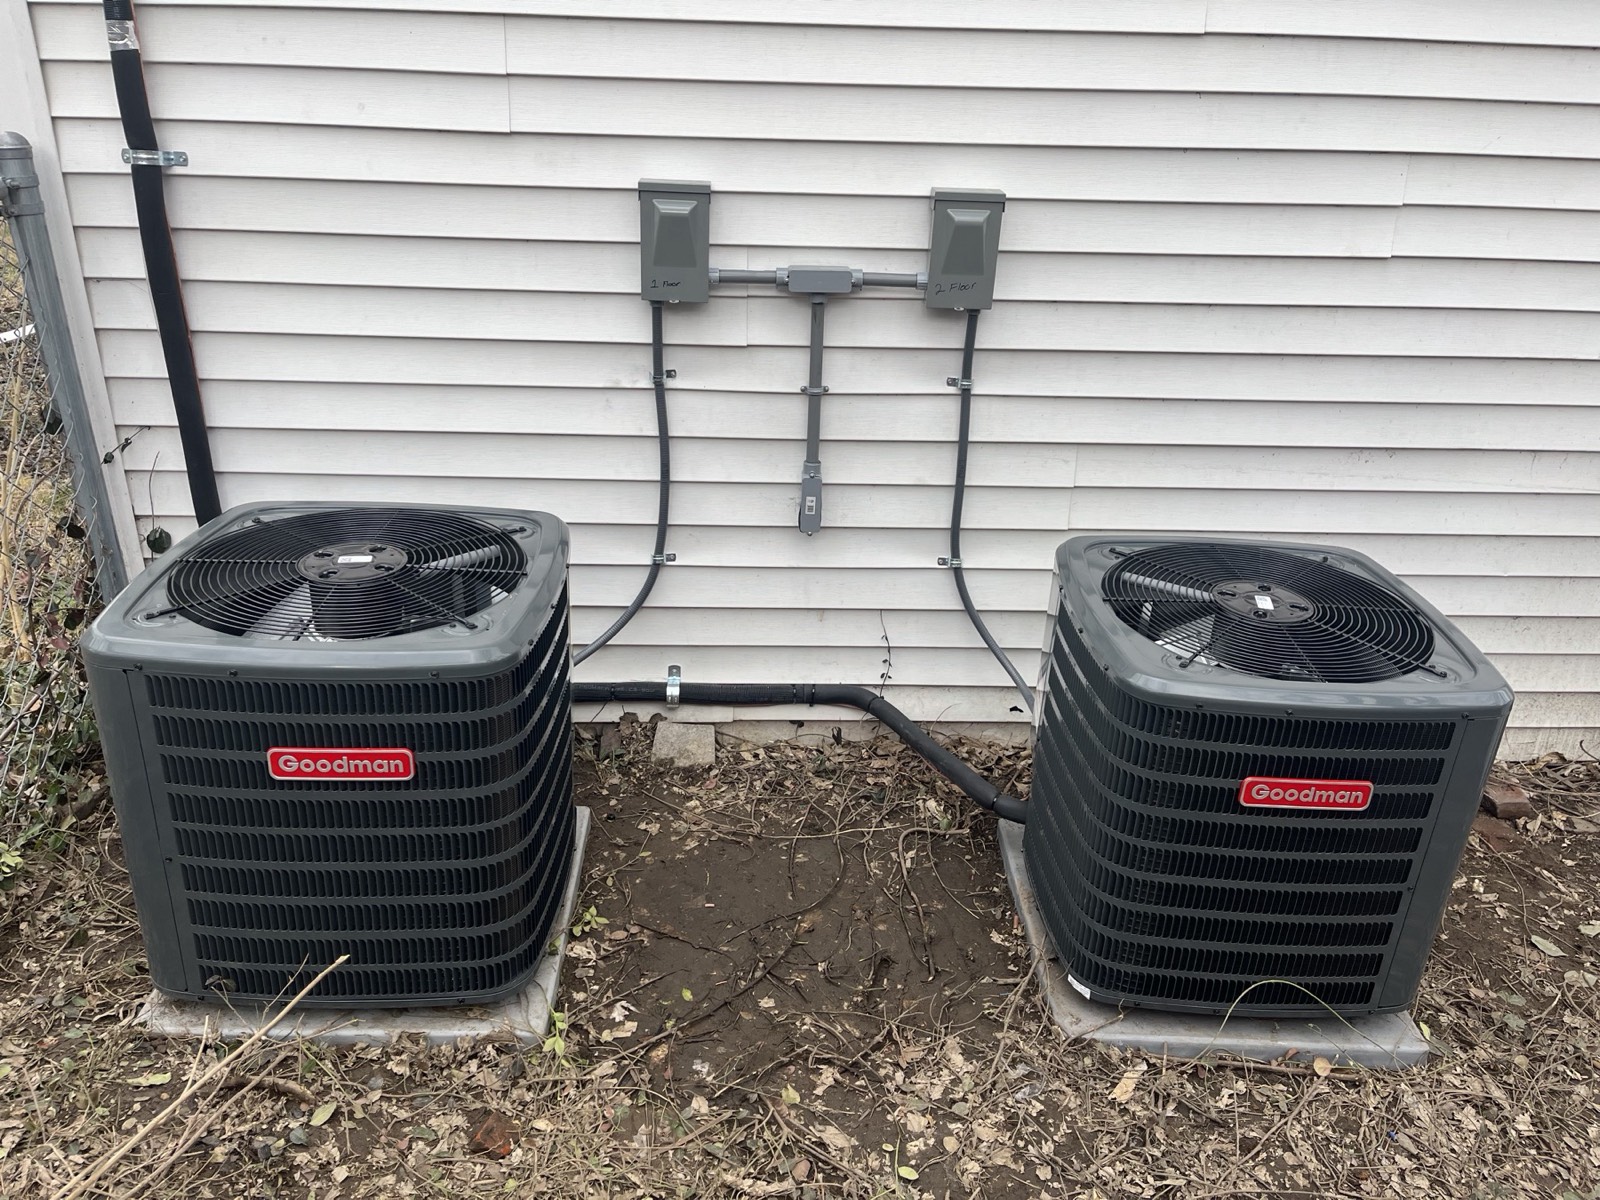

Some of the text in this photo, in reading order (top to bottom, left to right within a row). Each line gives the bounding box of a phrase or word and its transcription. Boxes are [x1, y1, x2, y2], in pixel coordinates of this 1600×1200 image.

[934, 281, 977, 295] 2 Floor
[278, 755, 404, 773] Goodman
[1251, 784, 1363, 804] Goodman
